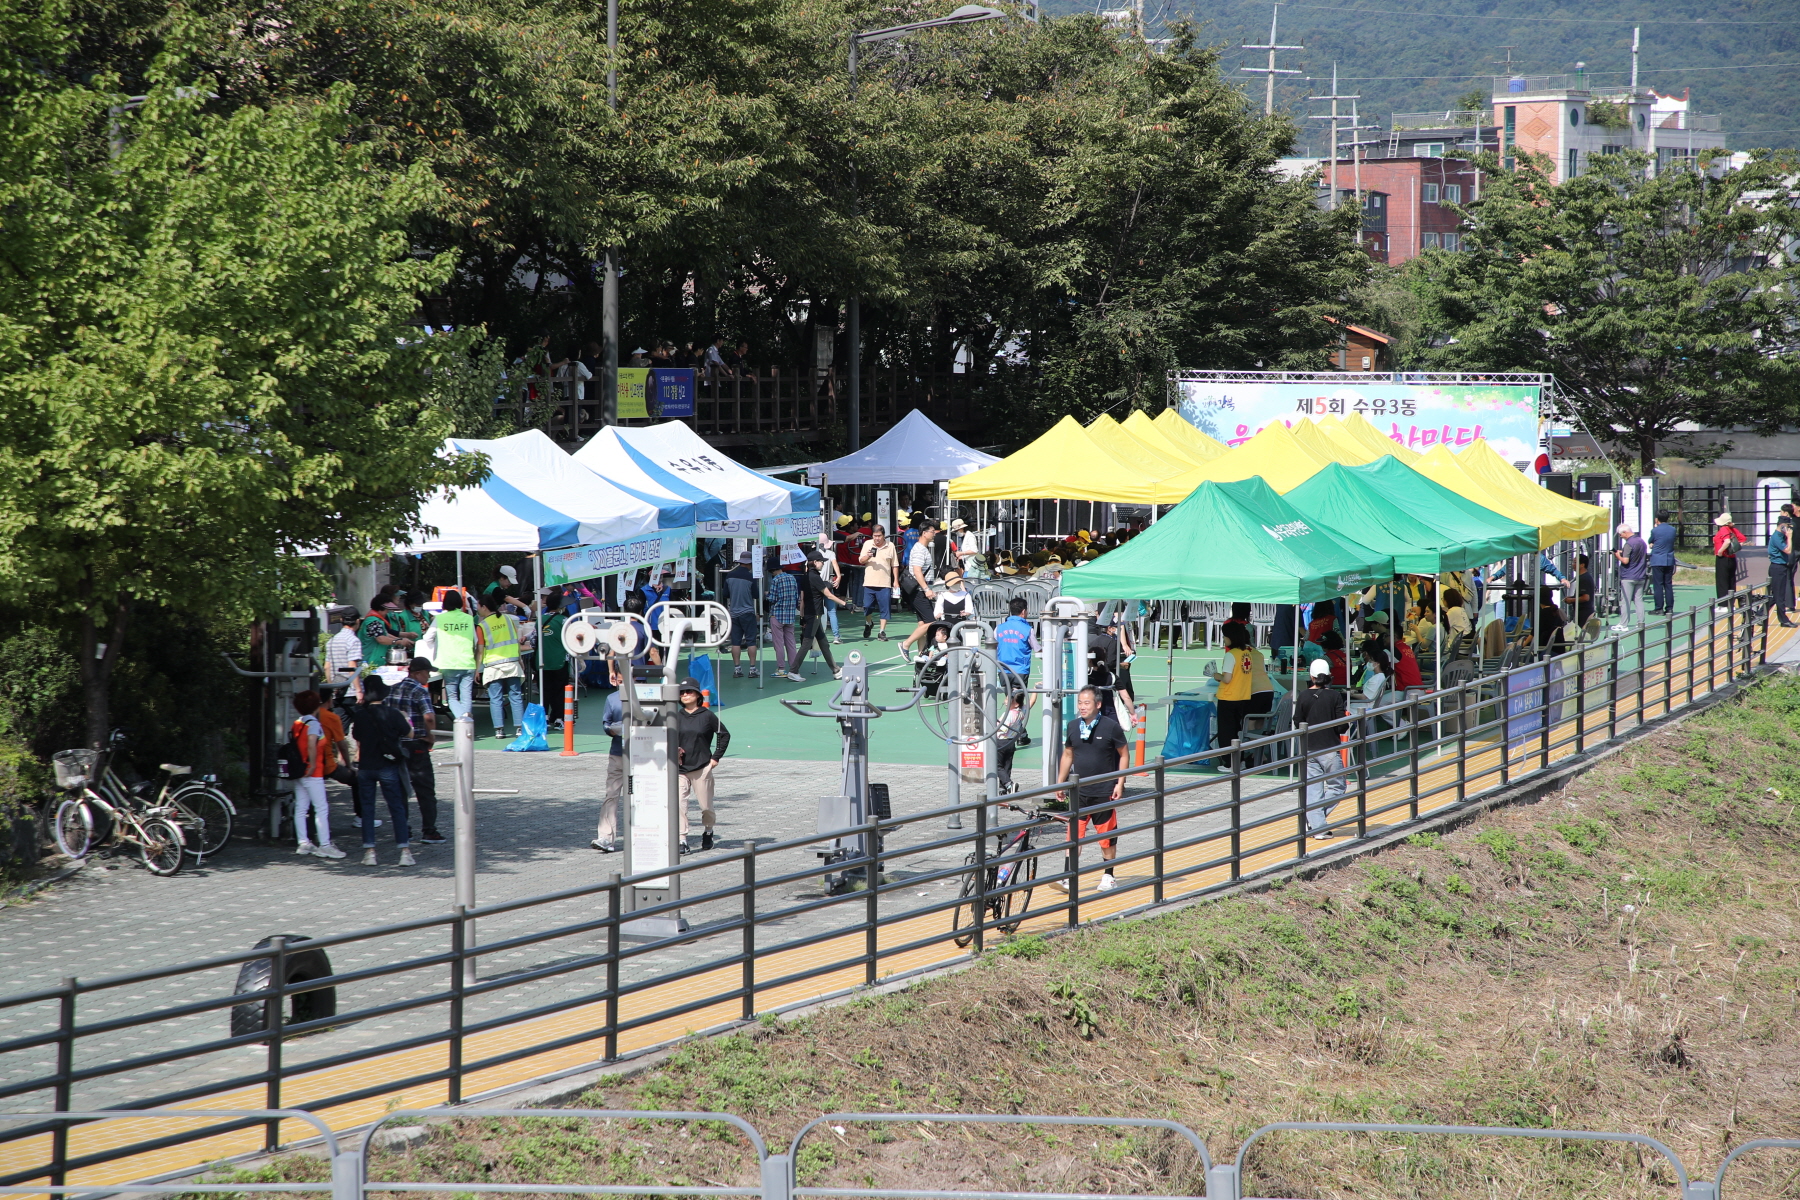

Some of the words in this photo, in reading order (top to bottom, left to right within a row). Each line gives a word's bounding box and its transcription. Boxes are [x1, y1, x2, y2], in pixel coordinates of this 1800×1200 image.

[1296, 396, 1345, 415] 제5회
[1352, 397, 1417, 416] 수유3동
[443, 623, 469, 632] STAFF
[491, 623, 507, 631] STAFF
